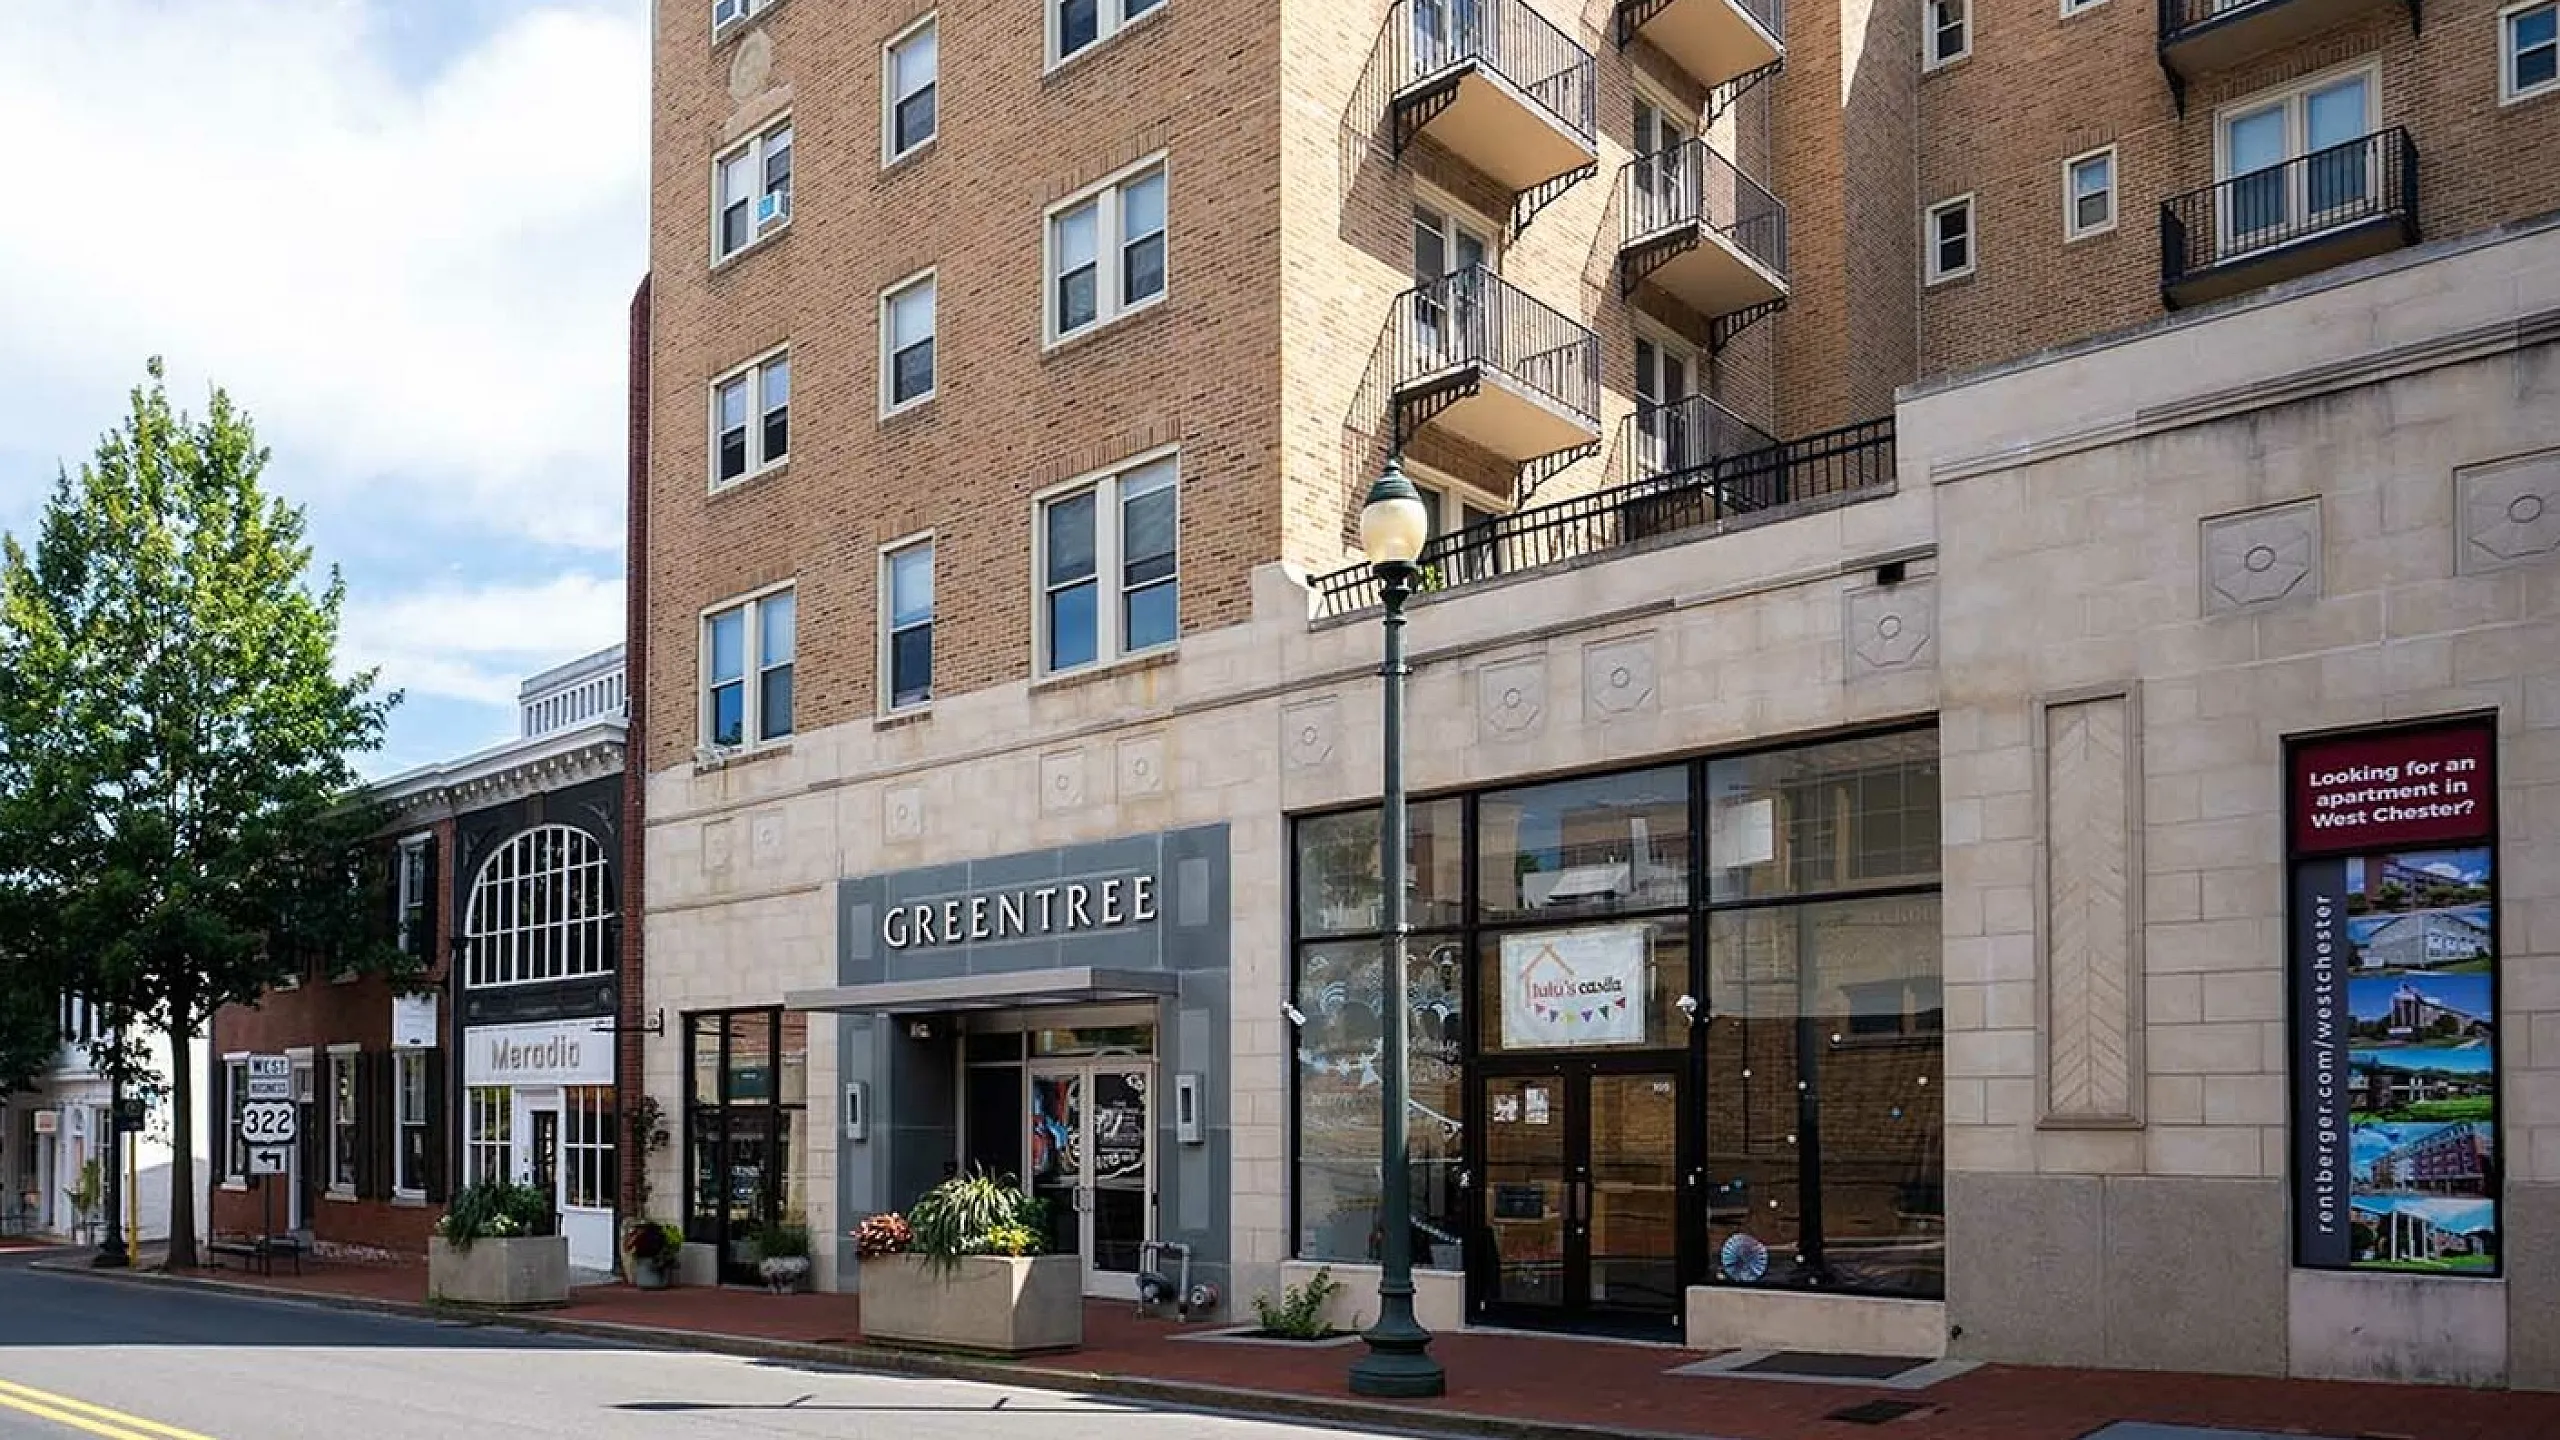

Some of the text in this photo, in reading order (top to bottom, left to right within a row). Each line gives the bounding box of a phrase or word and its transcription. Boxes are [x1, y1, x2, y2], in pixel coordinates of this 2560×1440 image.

[2309, 757, 2477, 788] Looking for an
[2315, 778, 2469, 809] apartment in
[2311, 798, 2476, 829] West Chester?
[883, 876, 1158, 949] GREENTREE
[1533, 978, 1577, 998] lulu's
[2313, 894, 2338, 1234] rentberger.com/westchester
[246, 1109, 291, 1134] 322
